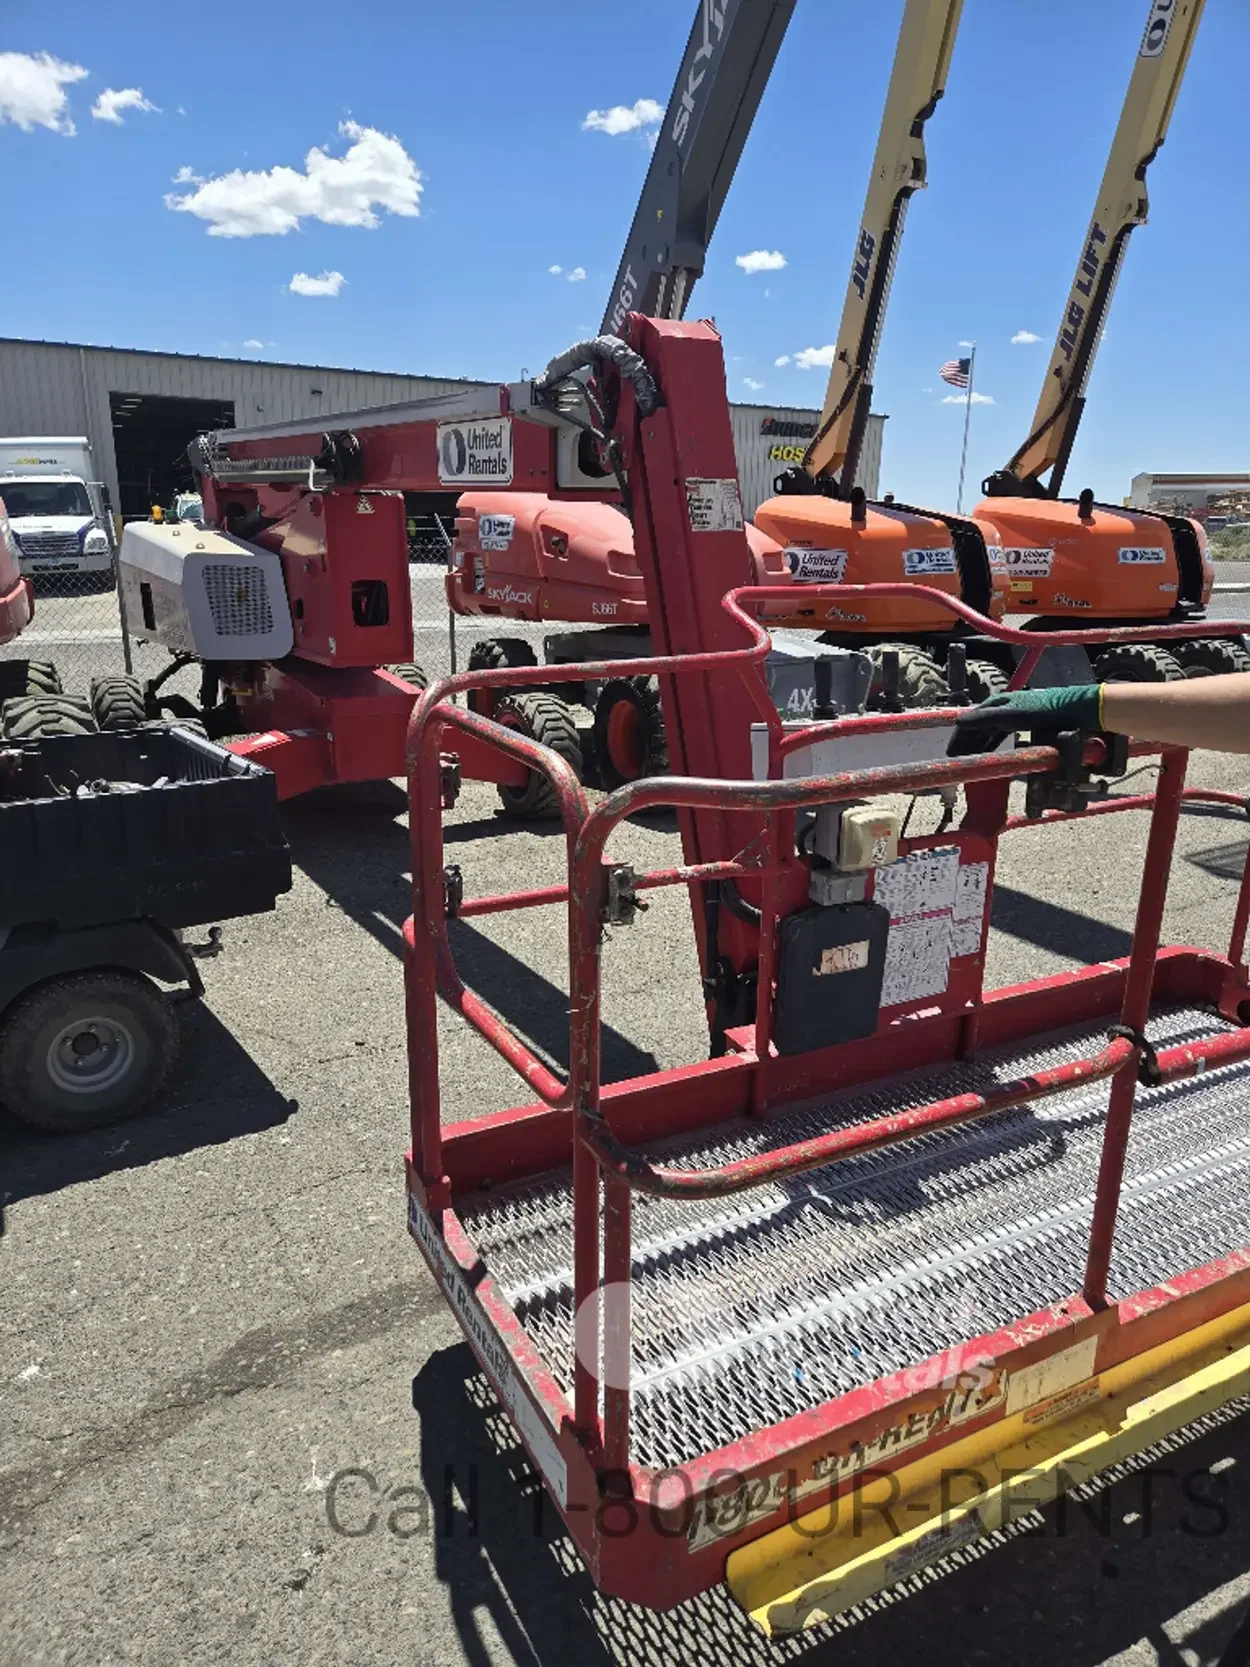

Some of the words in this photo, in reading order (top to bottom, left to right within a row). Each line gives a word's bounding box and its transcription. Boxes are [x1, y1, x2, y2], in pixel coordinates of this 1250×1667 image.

[852, 228, 876, 300] JLG
[1059, 301, 1085, 362] JLG
[1076, 221, 1107, 298] LIFT
[467, 424, 503, 450] United
[468, 451, 508, 475] Rentals
[768, 445, 806, 464] HOS
[802, 553, 842, 566] United
[799, 565, 839, 579] Rentals
[787, 687, 814, 712] 4X
